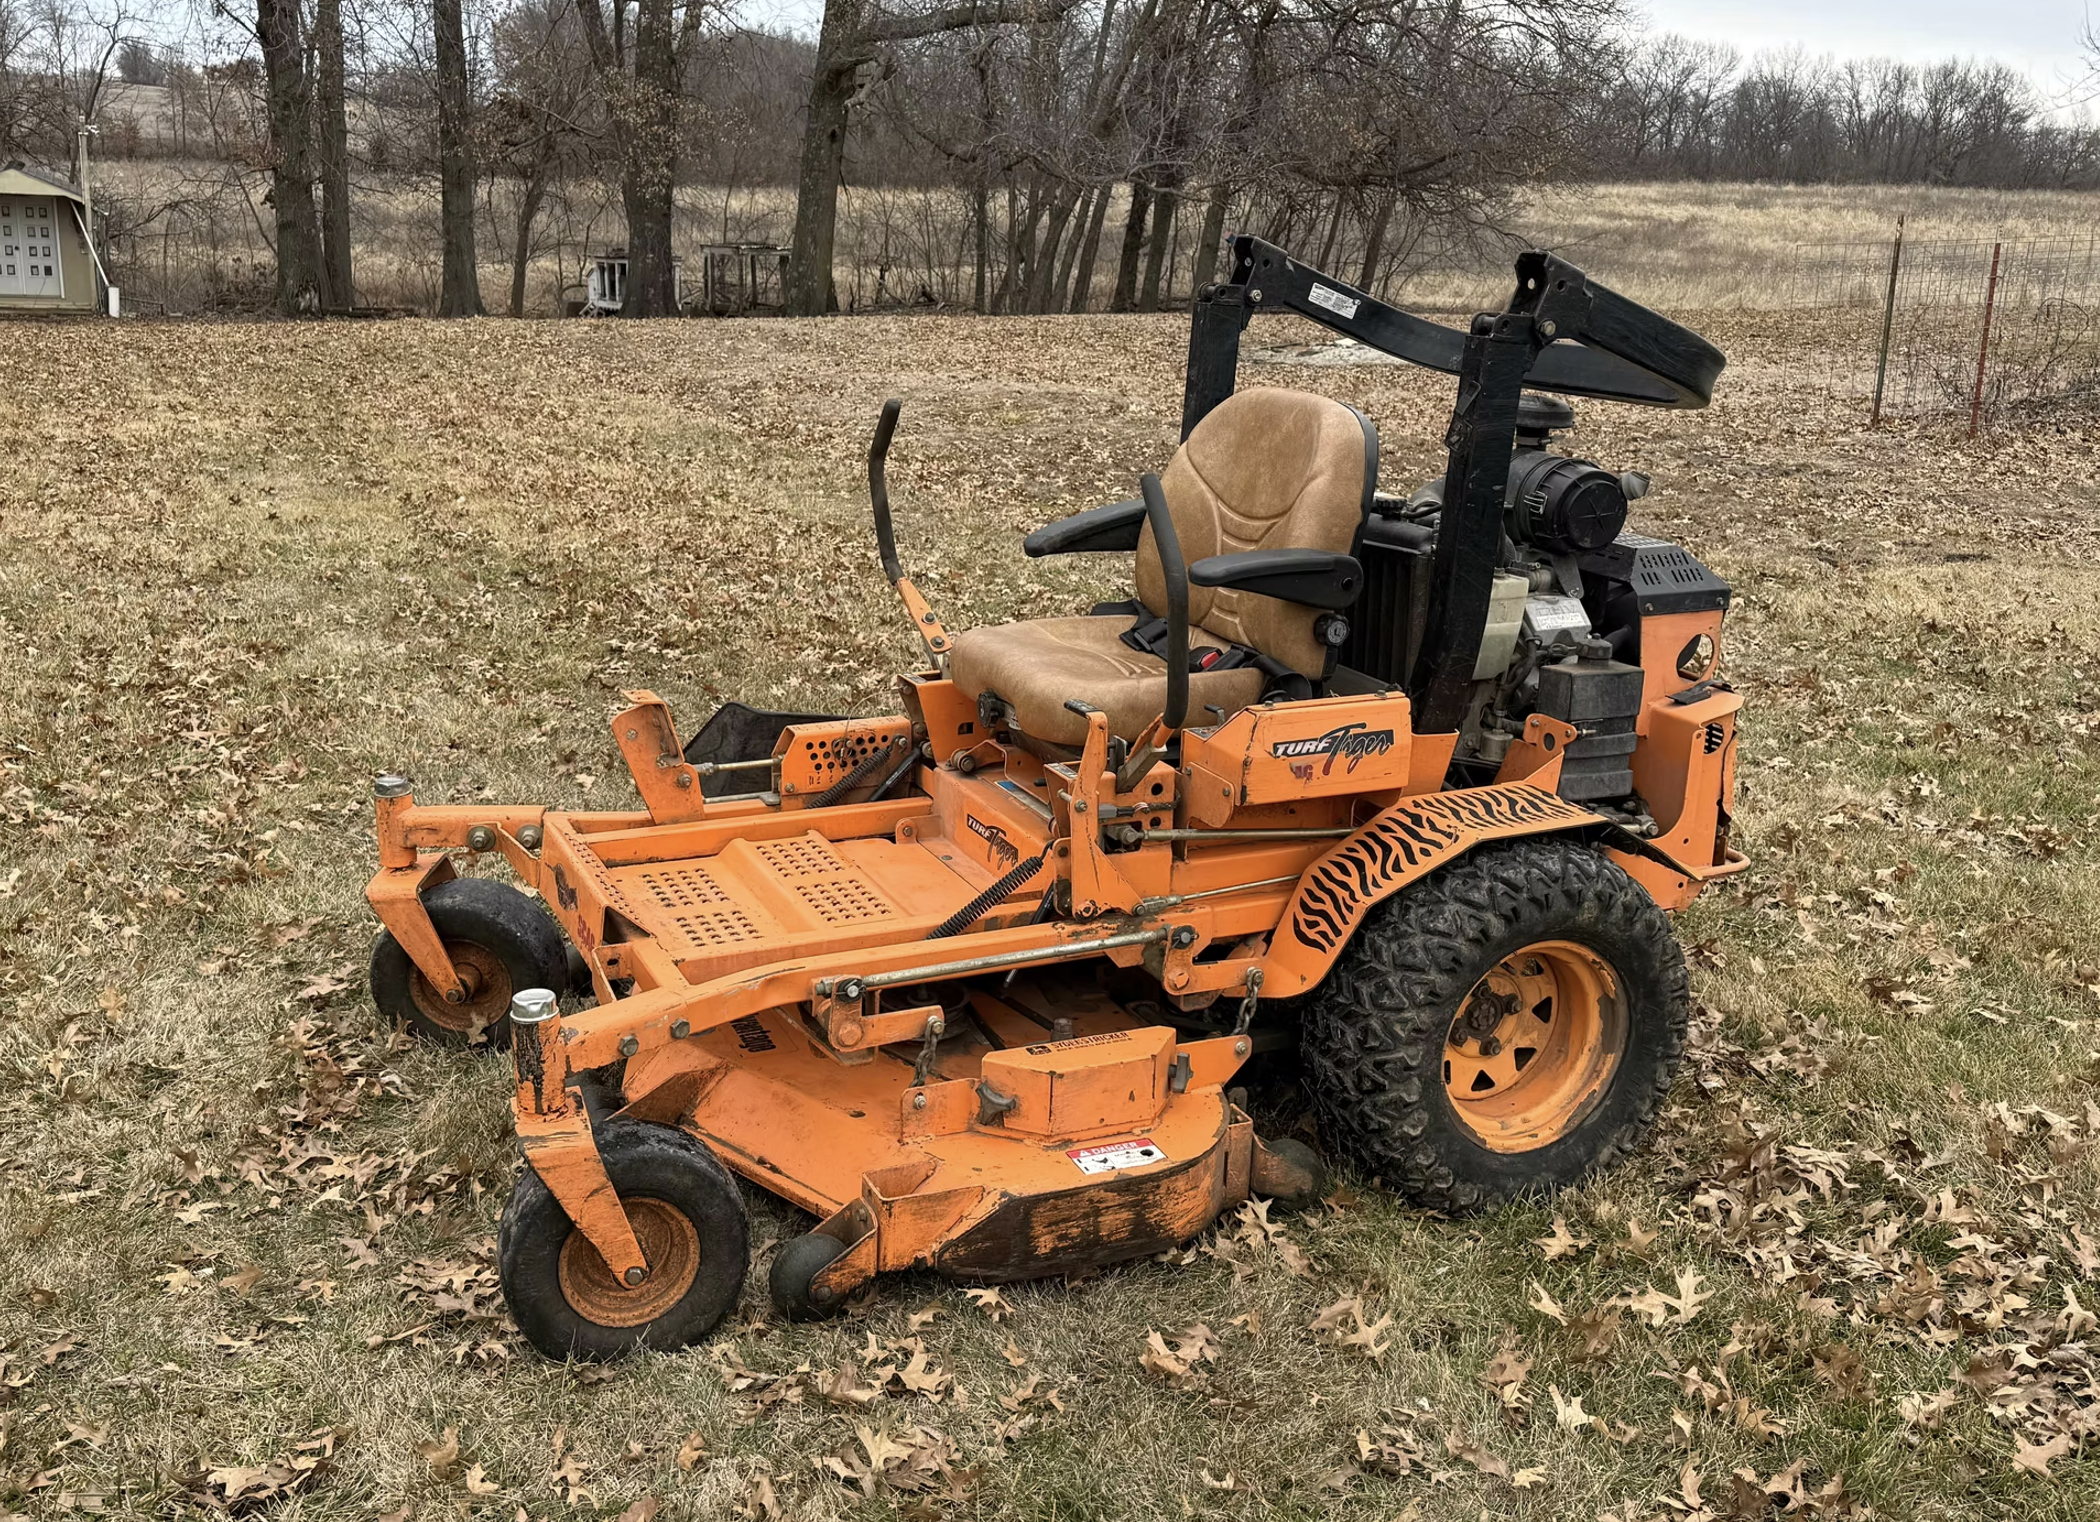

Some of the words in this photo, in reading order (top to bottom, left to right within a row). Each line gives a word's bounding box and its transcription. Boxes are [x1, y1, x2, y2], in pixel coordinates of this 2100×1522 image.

[1275, 738, 1332, 757] TURF
[1318, 722, 1392, 776] Tiger
[968, 816, 993, 839] TURF
[1090, 1141, 1139, 1155] DANGER
